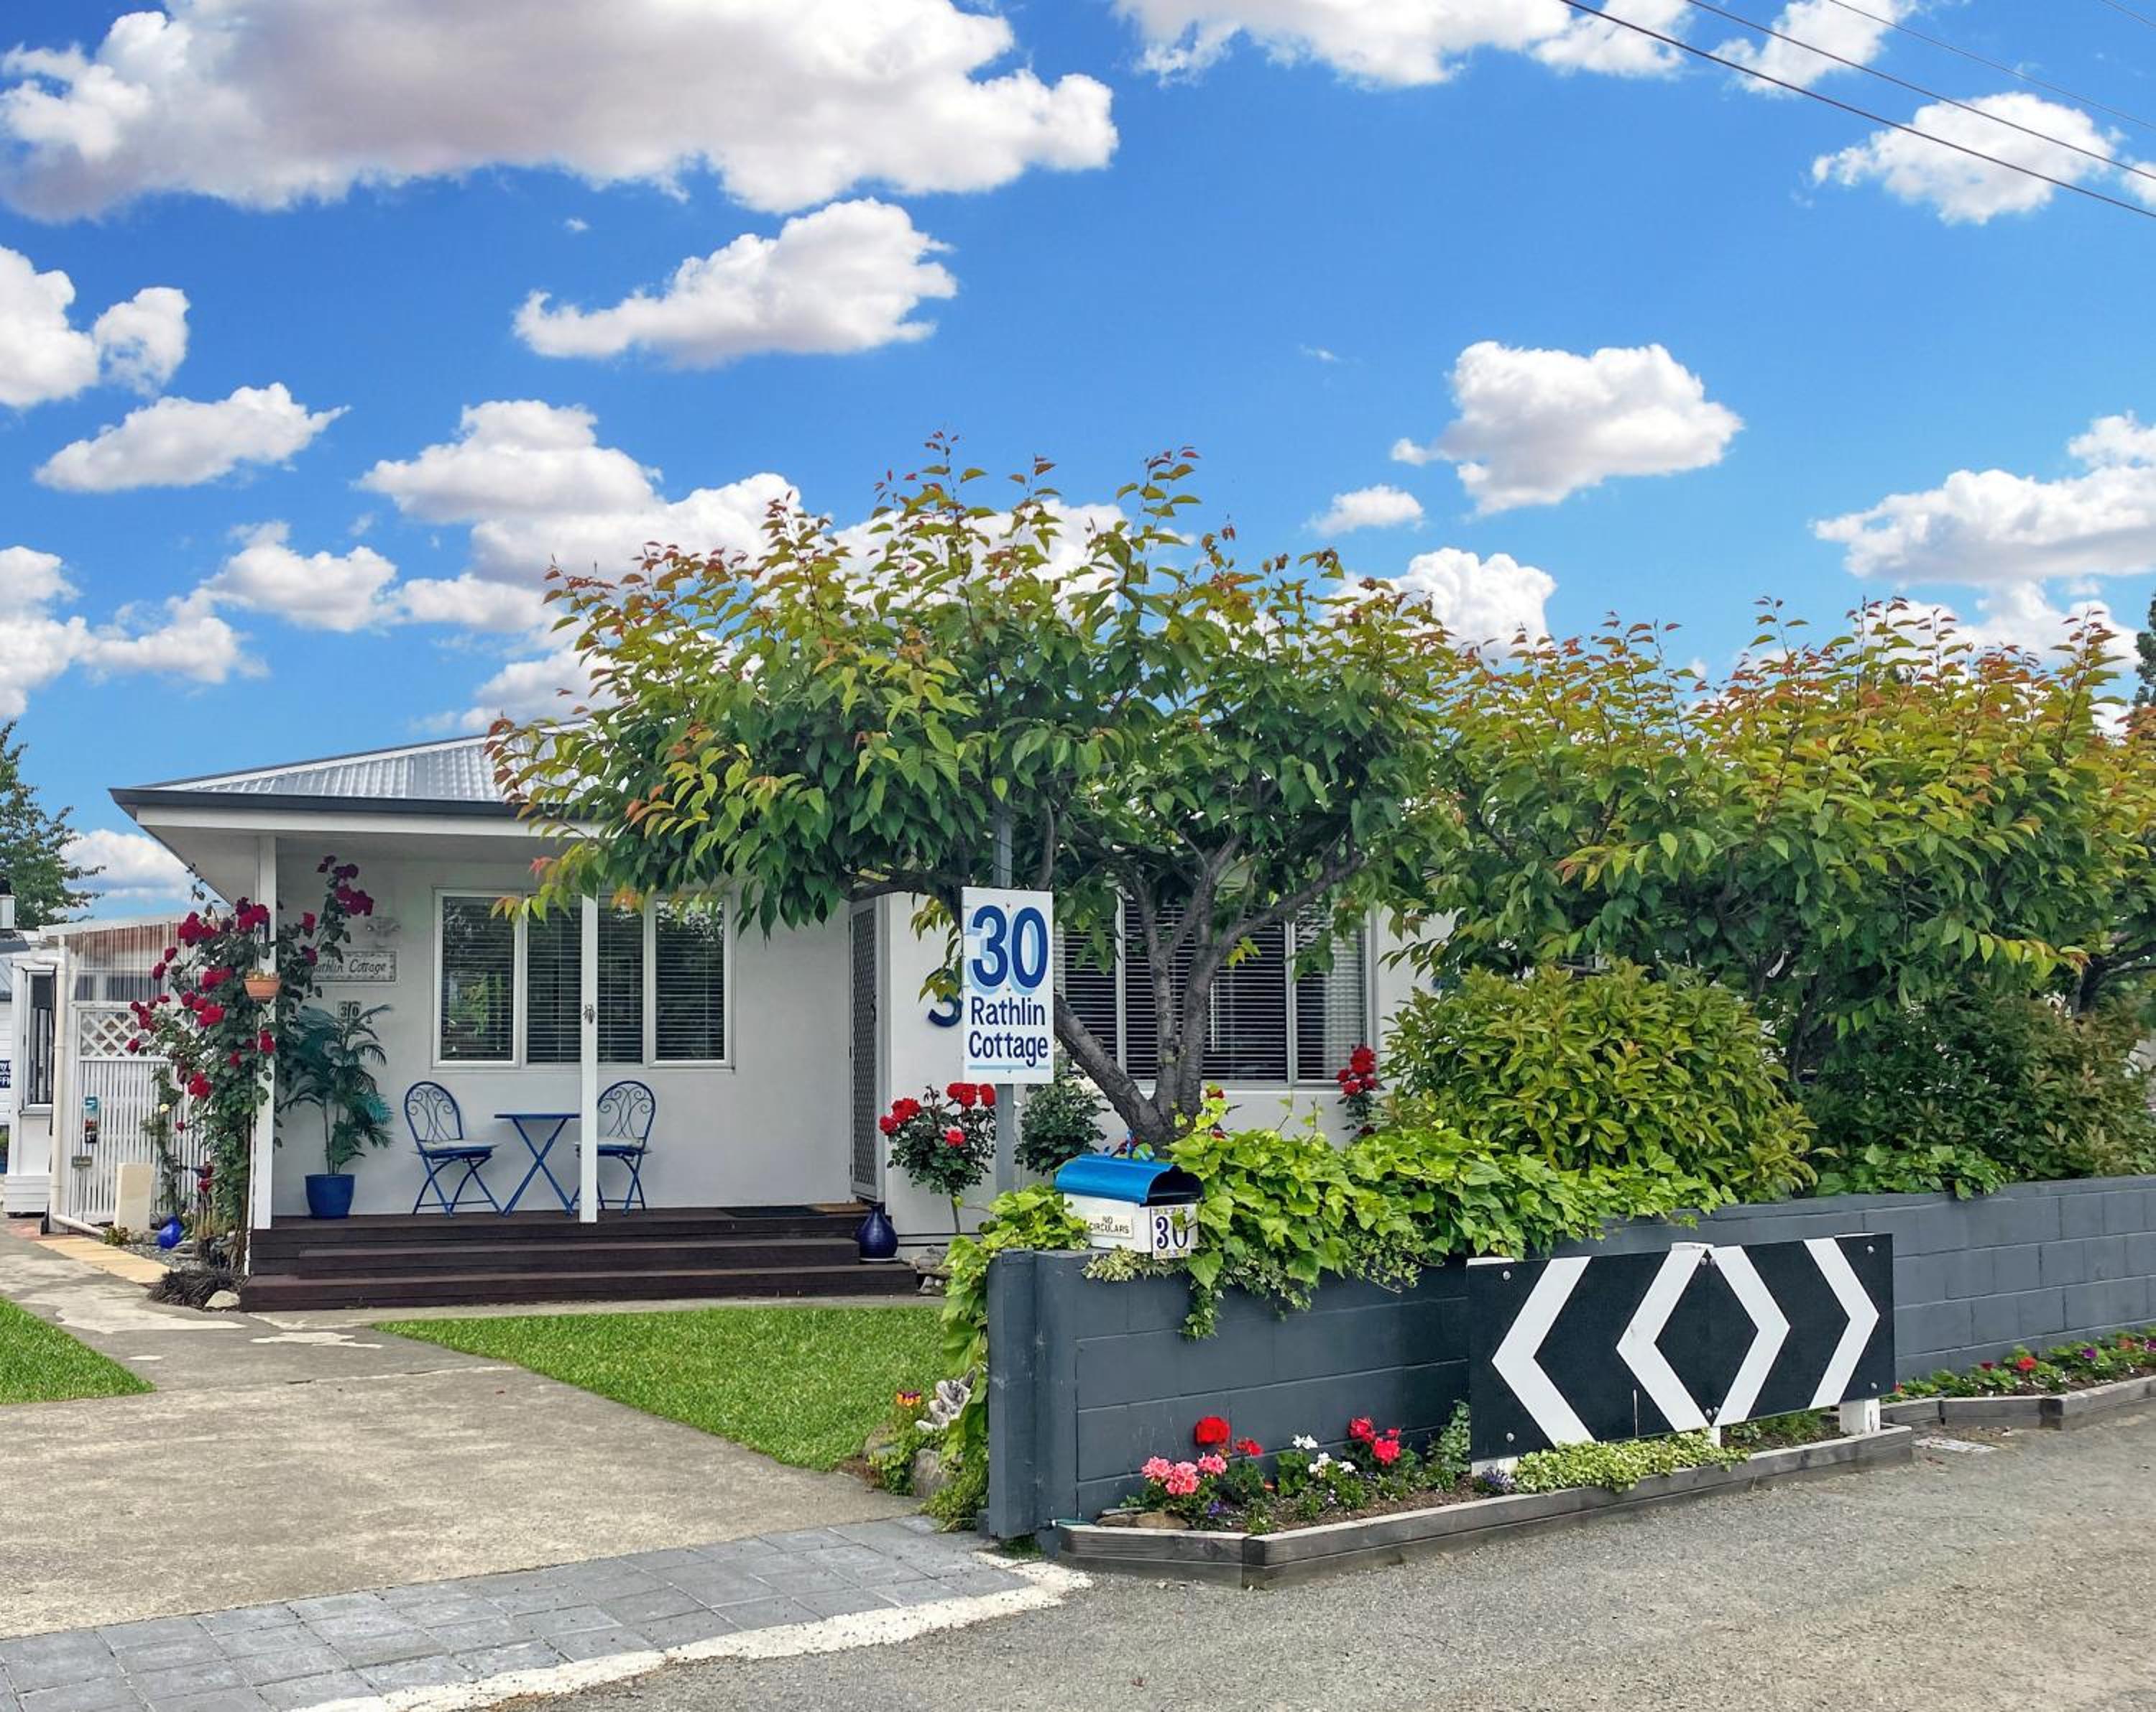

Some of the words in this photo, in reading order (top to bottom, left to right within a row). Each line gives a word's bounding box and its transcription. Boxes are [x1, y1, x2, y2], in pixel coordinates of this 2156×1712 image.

[970, 905, 1048, 991] 30
[312, 959, 344, 972] athlin
[349, 958, 386, 975] Cottage
[340, 1005, 359, 1018] 30
[971, 996, 1046, 1026] Rathlin
[969, 1031, 1049, 1067] Cottage
[1089, 1223, 1129, 1234] CIRCULARS
[1155, 1216, 1188, 1249] 30
